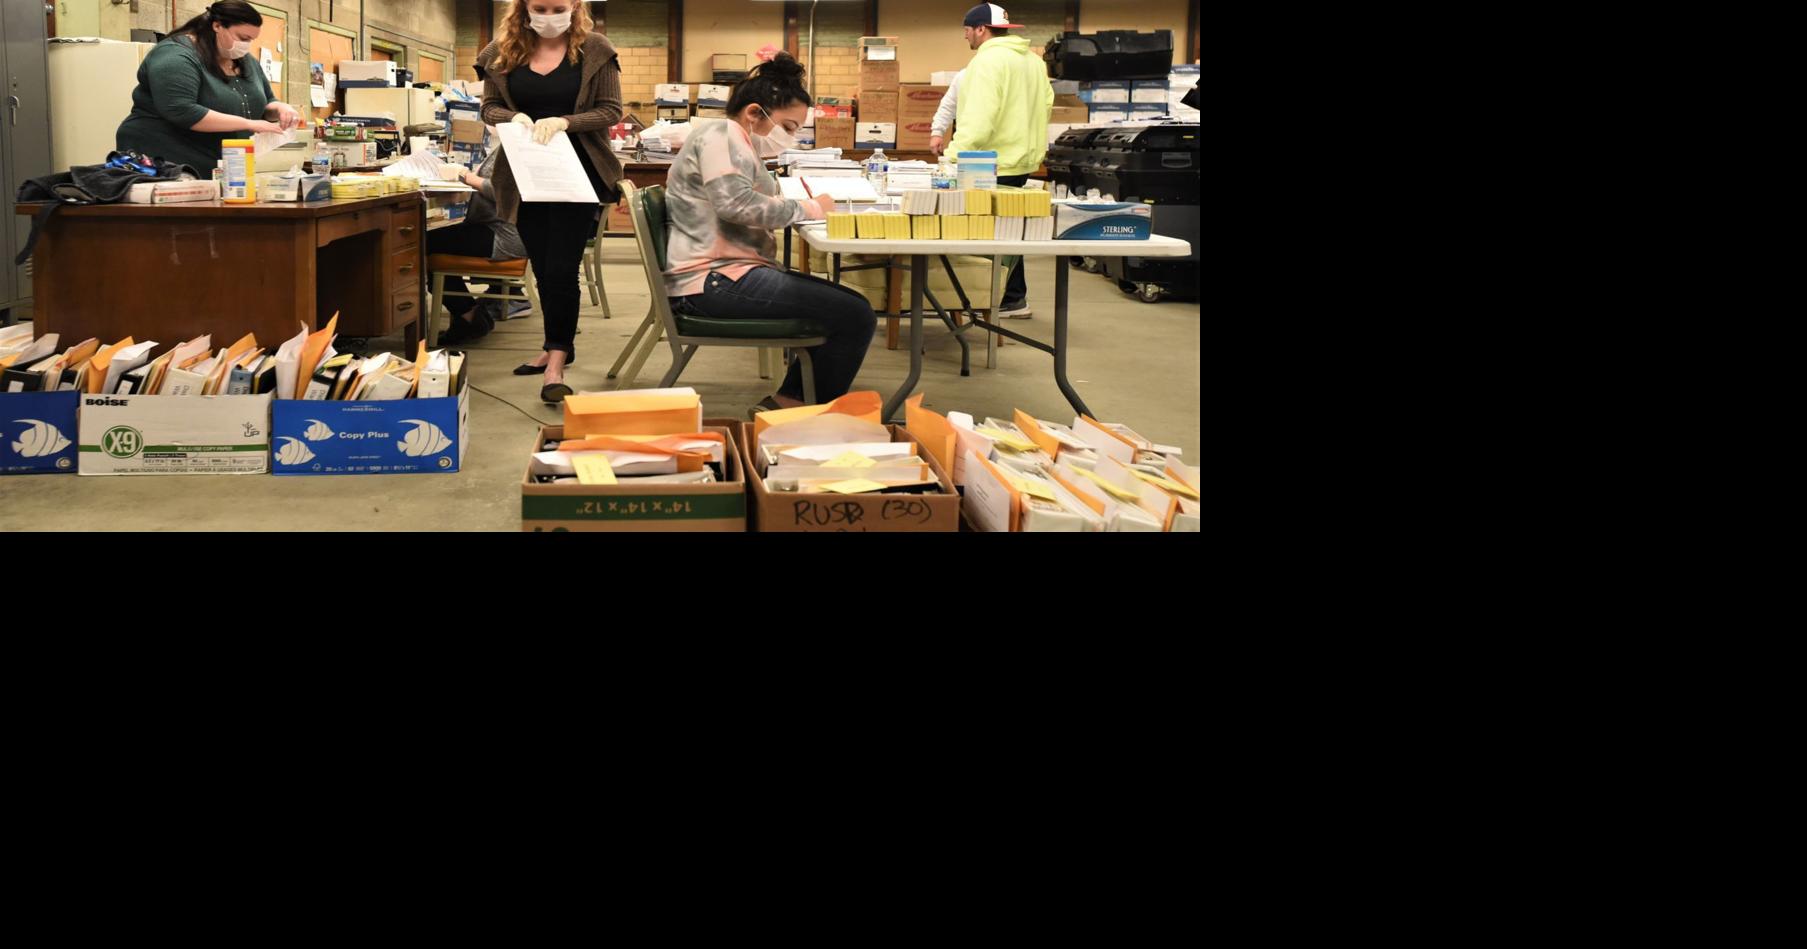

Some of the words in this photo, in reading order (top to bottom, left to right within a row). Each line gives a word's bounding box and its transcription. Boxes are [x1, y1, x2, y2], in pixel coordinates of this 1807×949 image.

[1102, 225, 1134, 233] STERLING
[339, 431, 365, 440] Copy
[881, 498, 933, 524] (30)
